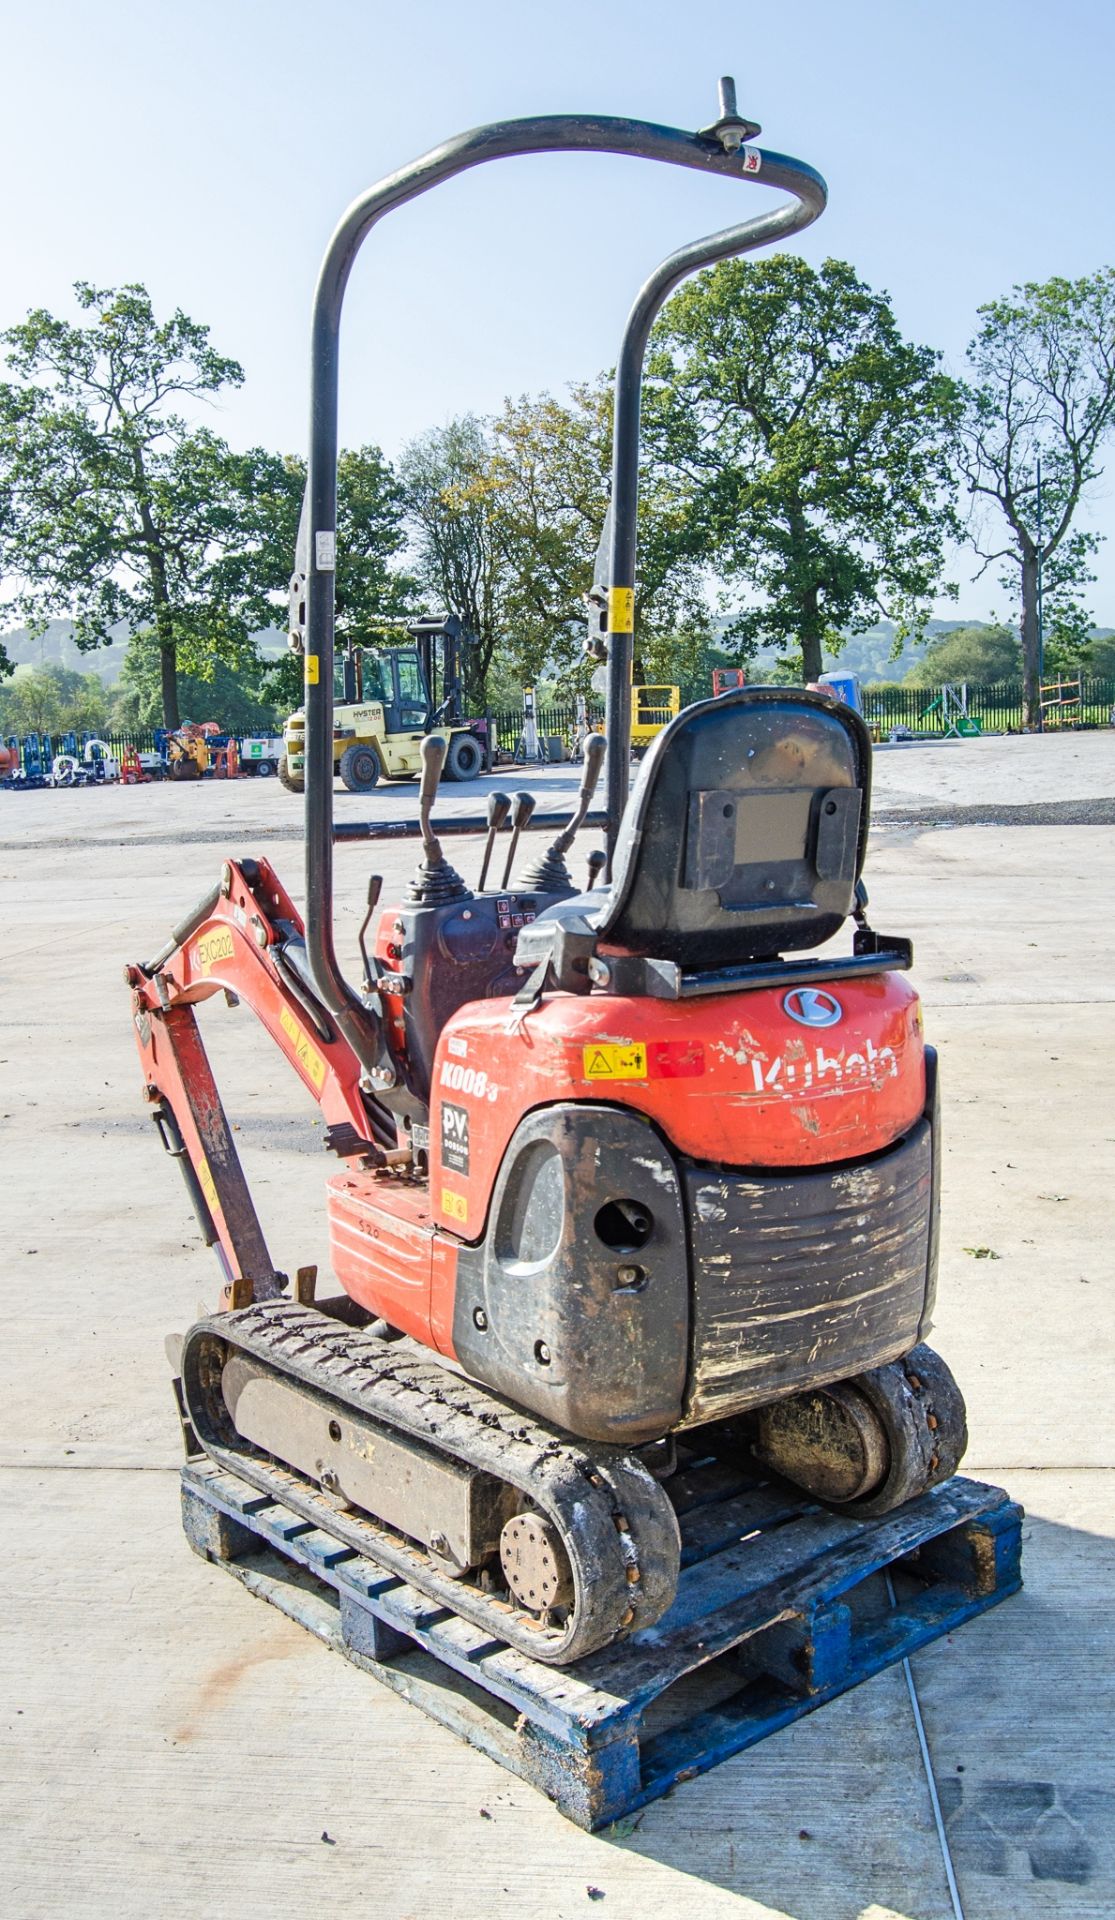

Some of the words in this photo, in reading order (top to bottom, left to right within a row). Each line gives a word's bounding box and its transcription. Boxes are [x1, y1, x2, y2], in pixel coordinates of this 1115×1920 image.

[353, 708, 381, 718] HYSTER
[199, 934, 233, 964] EXC202
[440, 1060, 498, 1102] K008-3
[443, 1107, 468, 1142] P.V.
